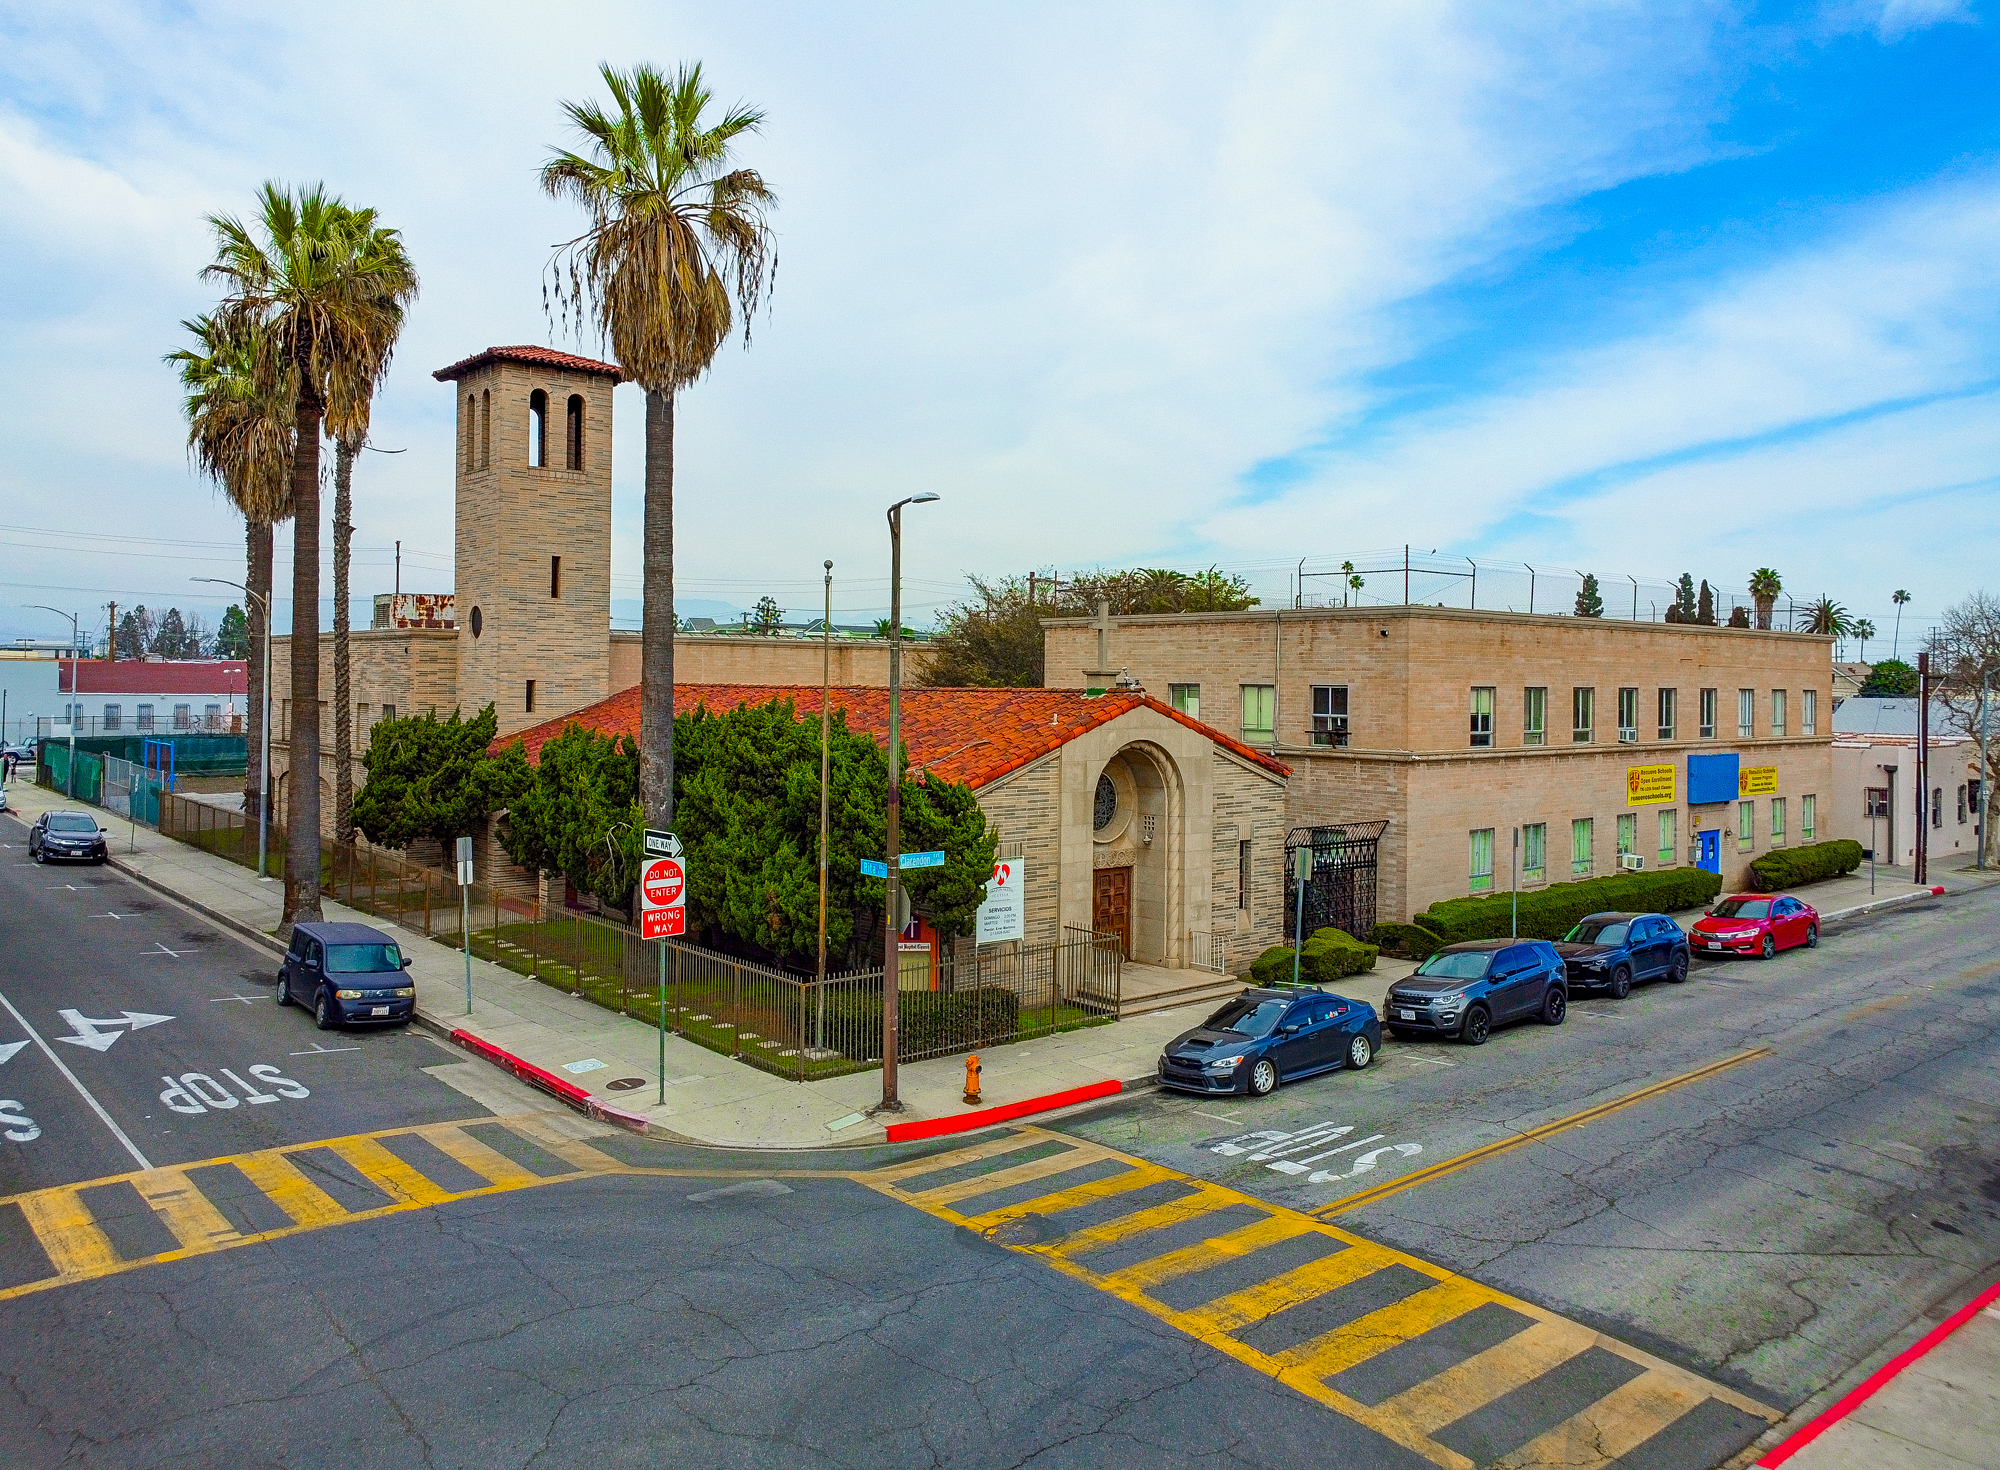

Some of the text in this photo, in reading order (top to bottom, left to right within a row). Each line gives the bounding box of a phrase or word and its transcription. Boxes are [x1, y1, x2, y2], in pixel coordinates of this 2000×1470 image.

[1630, 792, 1672, 802] renuevoschools.org
[648, 838, 672, 850] ONE WAY
[900, 854, 930, 866] Clarendon
[650, 868, 678, 879] DO NOT
[864, 862, 876, 874] Rita
[650, 887, 676, 898] ENTER
[648, 910, 680, 922] WRONG
[654, 923, 674, 934] WAY
[160, 1064, 310, 1114] STOP
[1210, 1121, 1422, 1183] STOP
